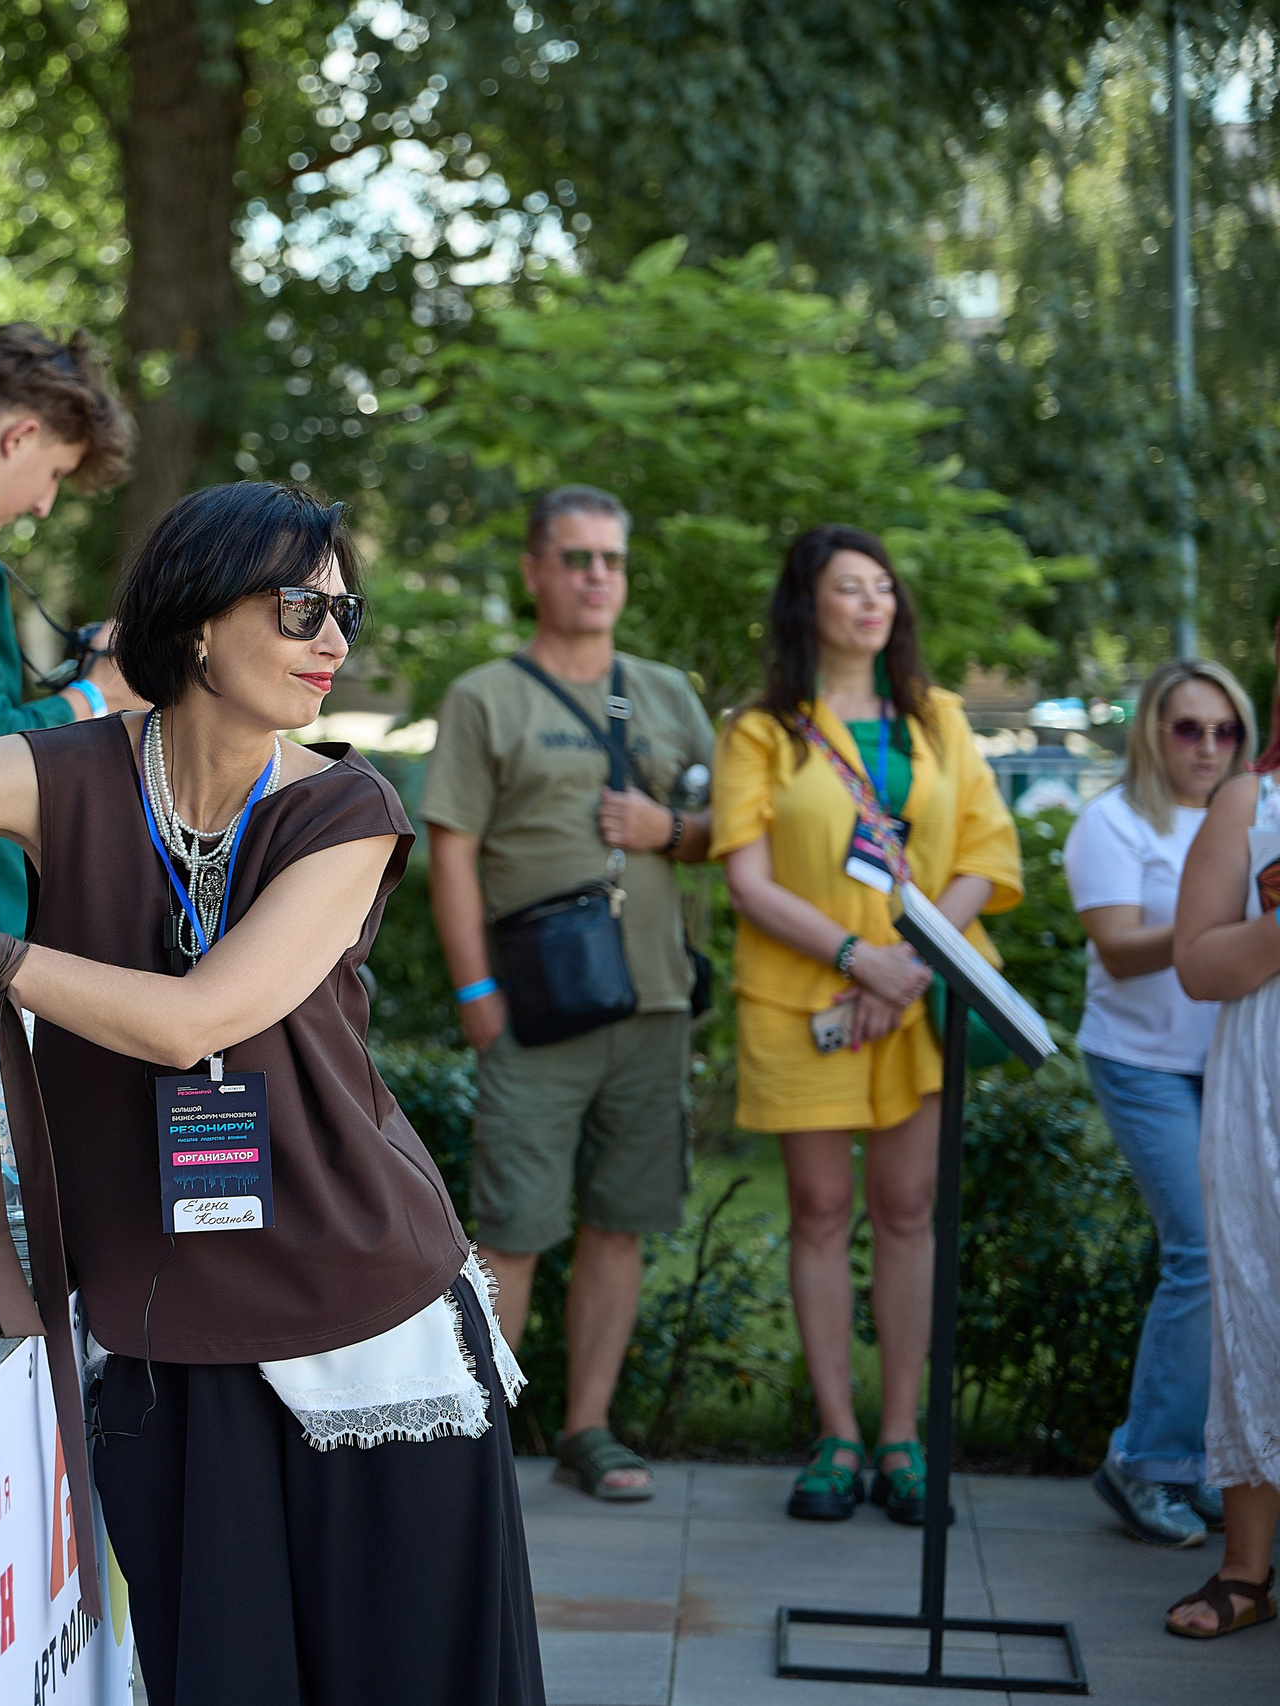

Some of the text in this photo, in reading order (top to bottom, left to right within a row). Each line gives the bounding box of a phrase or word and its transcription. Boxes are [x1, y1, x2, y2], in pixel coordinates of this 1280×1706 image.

[171, 1105, 202, 1113] БОЛЬШОЙ
[171, 1111, 257, 1122] БИЗНЕС-ФОРУМ ЧЕРНОЗЕМЬЯ
[170, 1119, 255, 1135] РЕЗОНИРУЙ
[177, 1151, 254, 1163] ОРГАНИЗАТОР
[182, 1199, 229, 1213] Елена
[34, 1635, 57, 1706] АРТ
